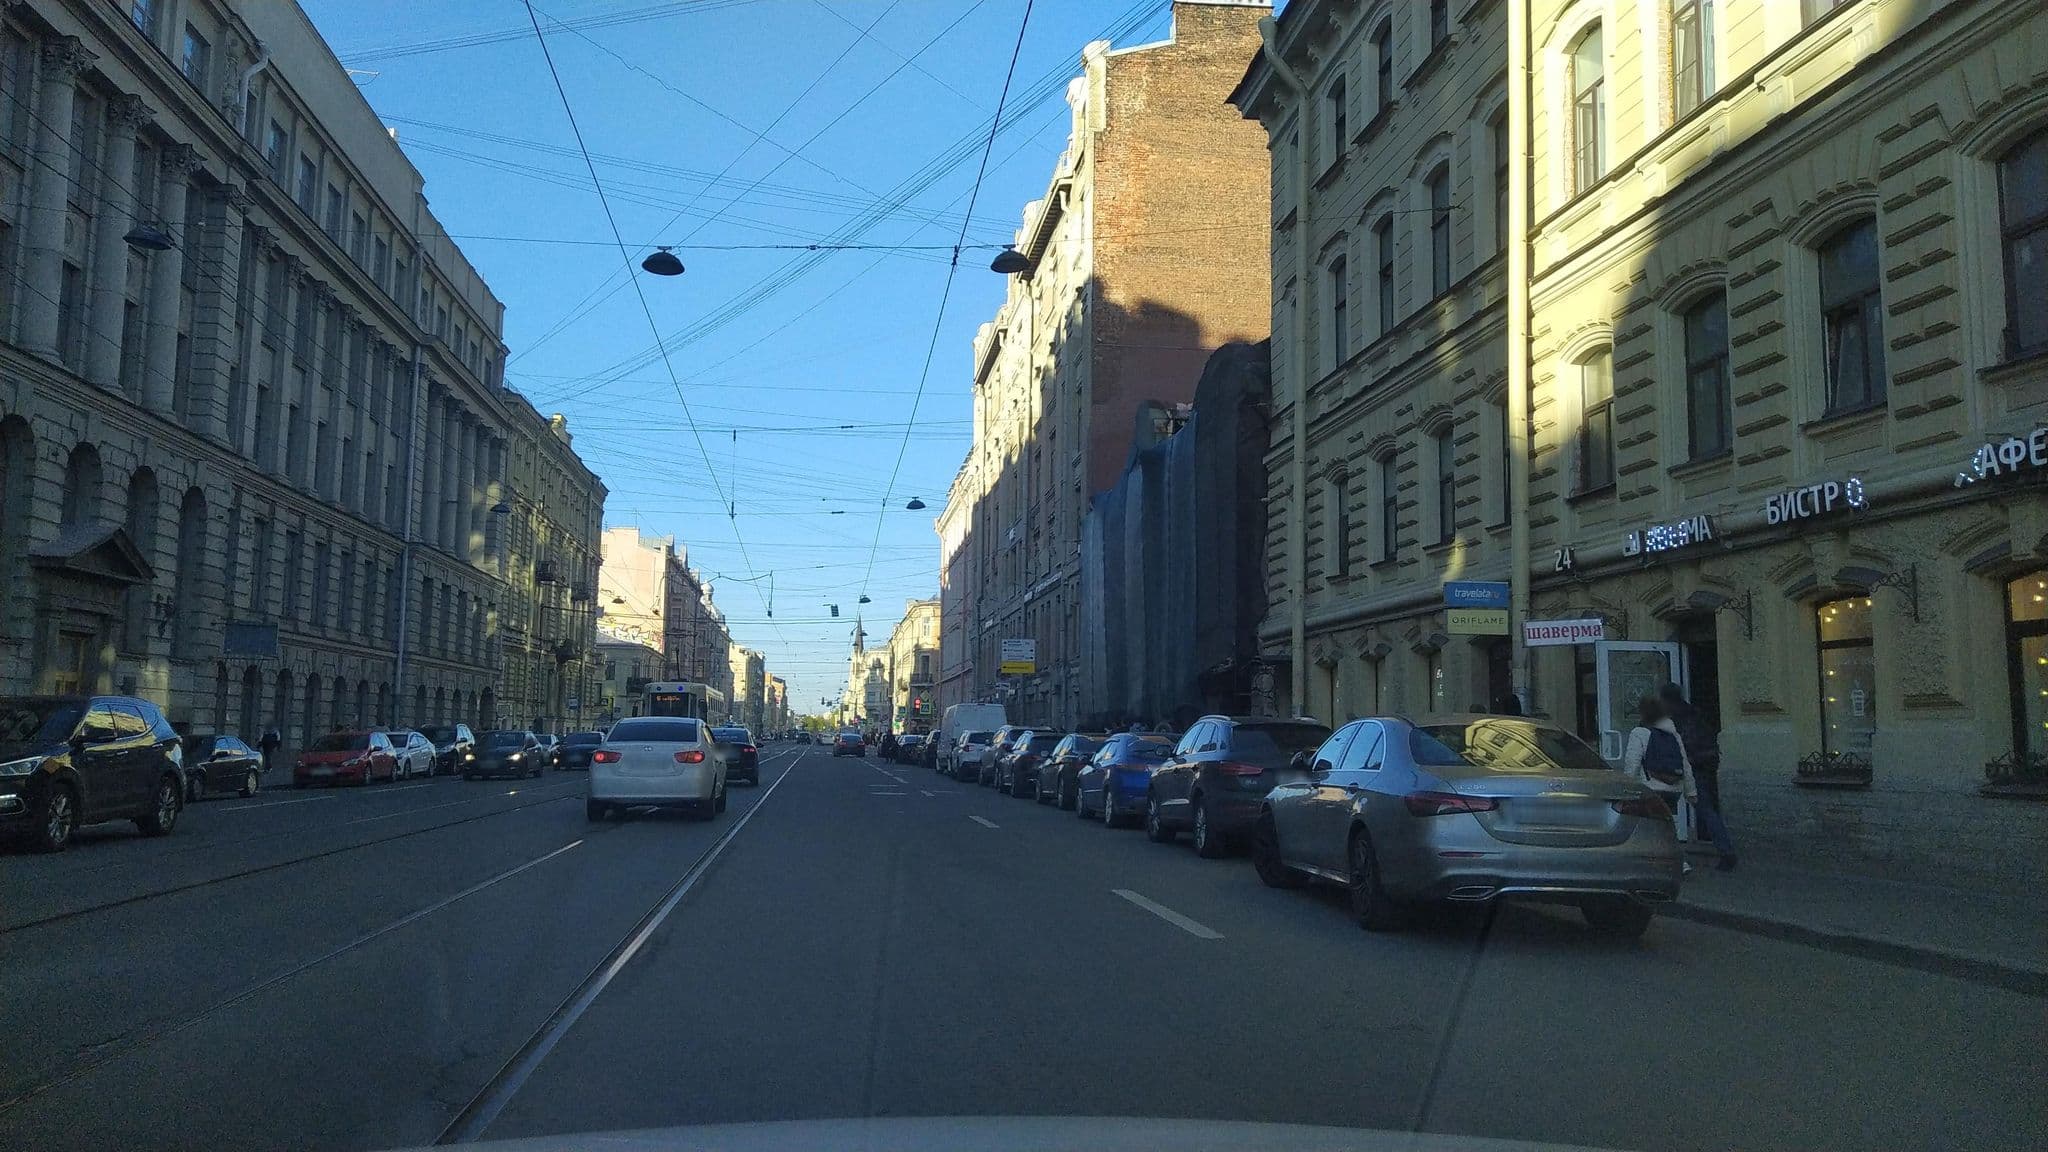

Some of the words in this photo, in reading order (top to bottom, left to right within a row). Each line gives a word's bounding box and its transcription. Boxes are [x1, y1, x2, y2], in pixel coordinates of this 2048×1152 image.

[1554, 547, 1572, 571] 24
[1766, 478, 1863, 525] БИСТРО
[1452, 617, 1505, 625] ORIFLAME
[1527, 624, 1602, 642] шаверма
